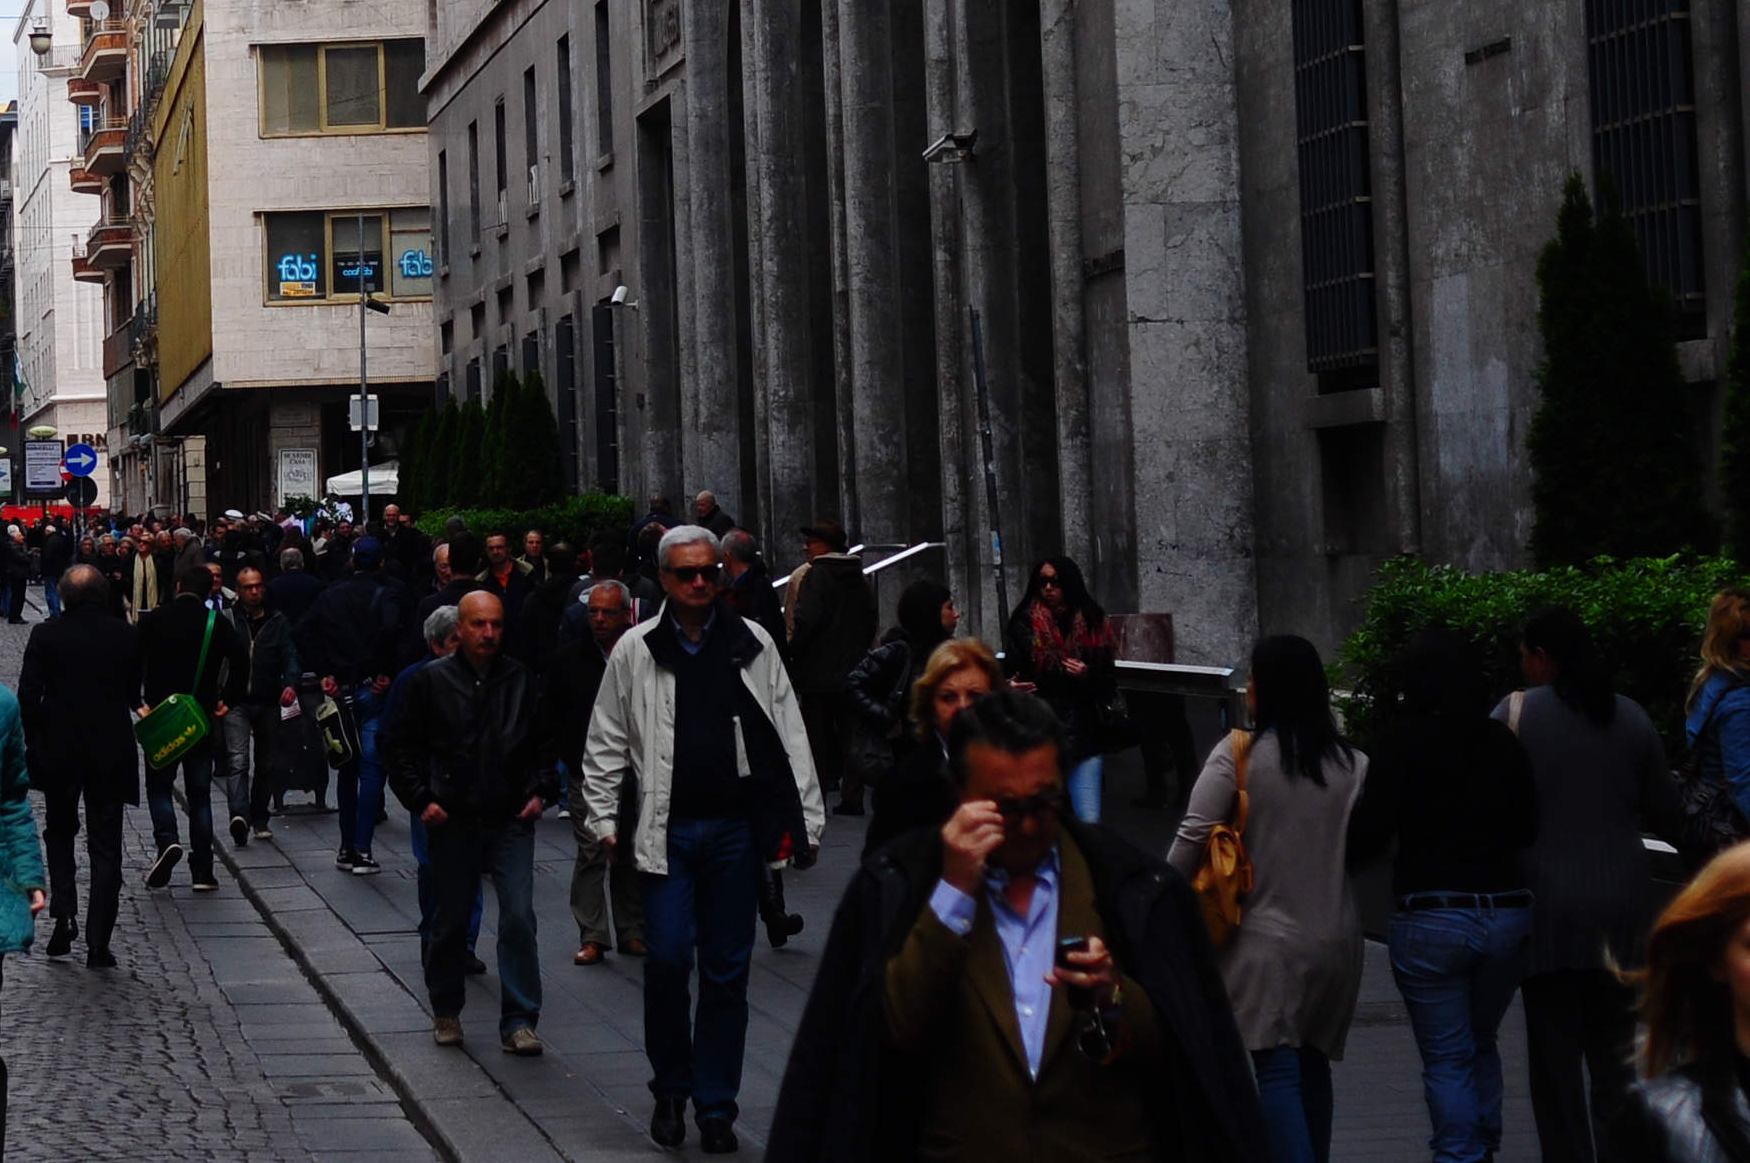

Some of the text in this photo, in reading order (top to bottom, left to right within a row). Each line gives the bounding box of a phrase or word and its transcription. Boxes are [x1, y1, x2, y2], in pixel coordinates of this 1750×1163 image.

[278, 254, 317, 281] fabi
[399, 249, 433, 277] fab
[154, 736, 186, 762] adidas
